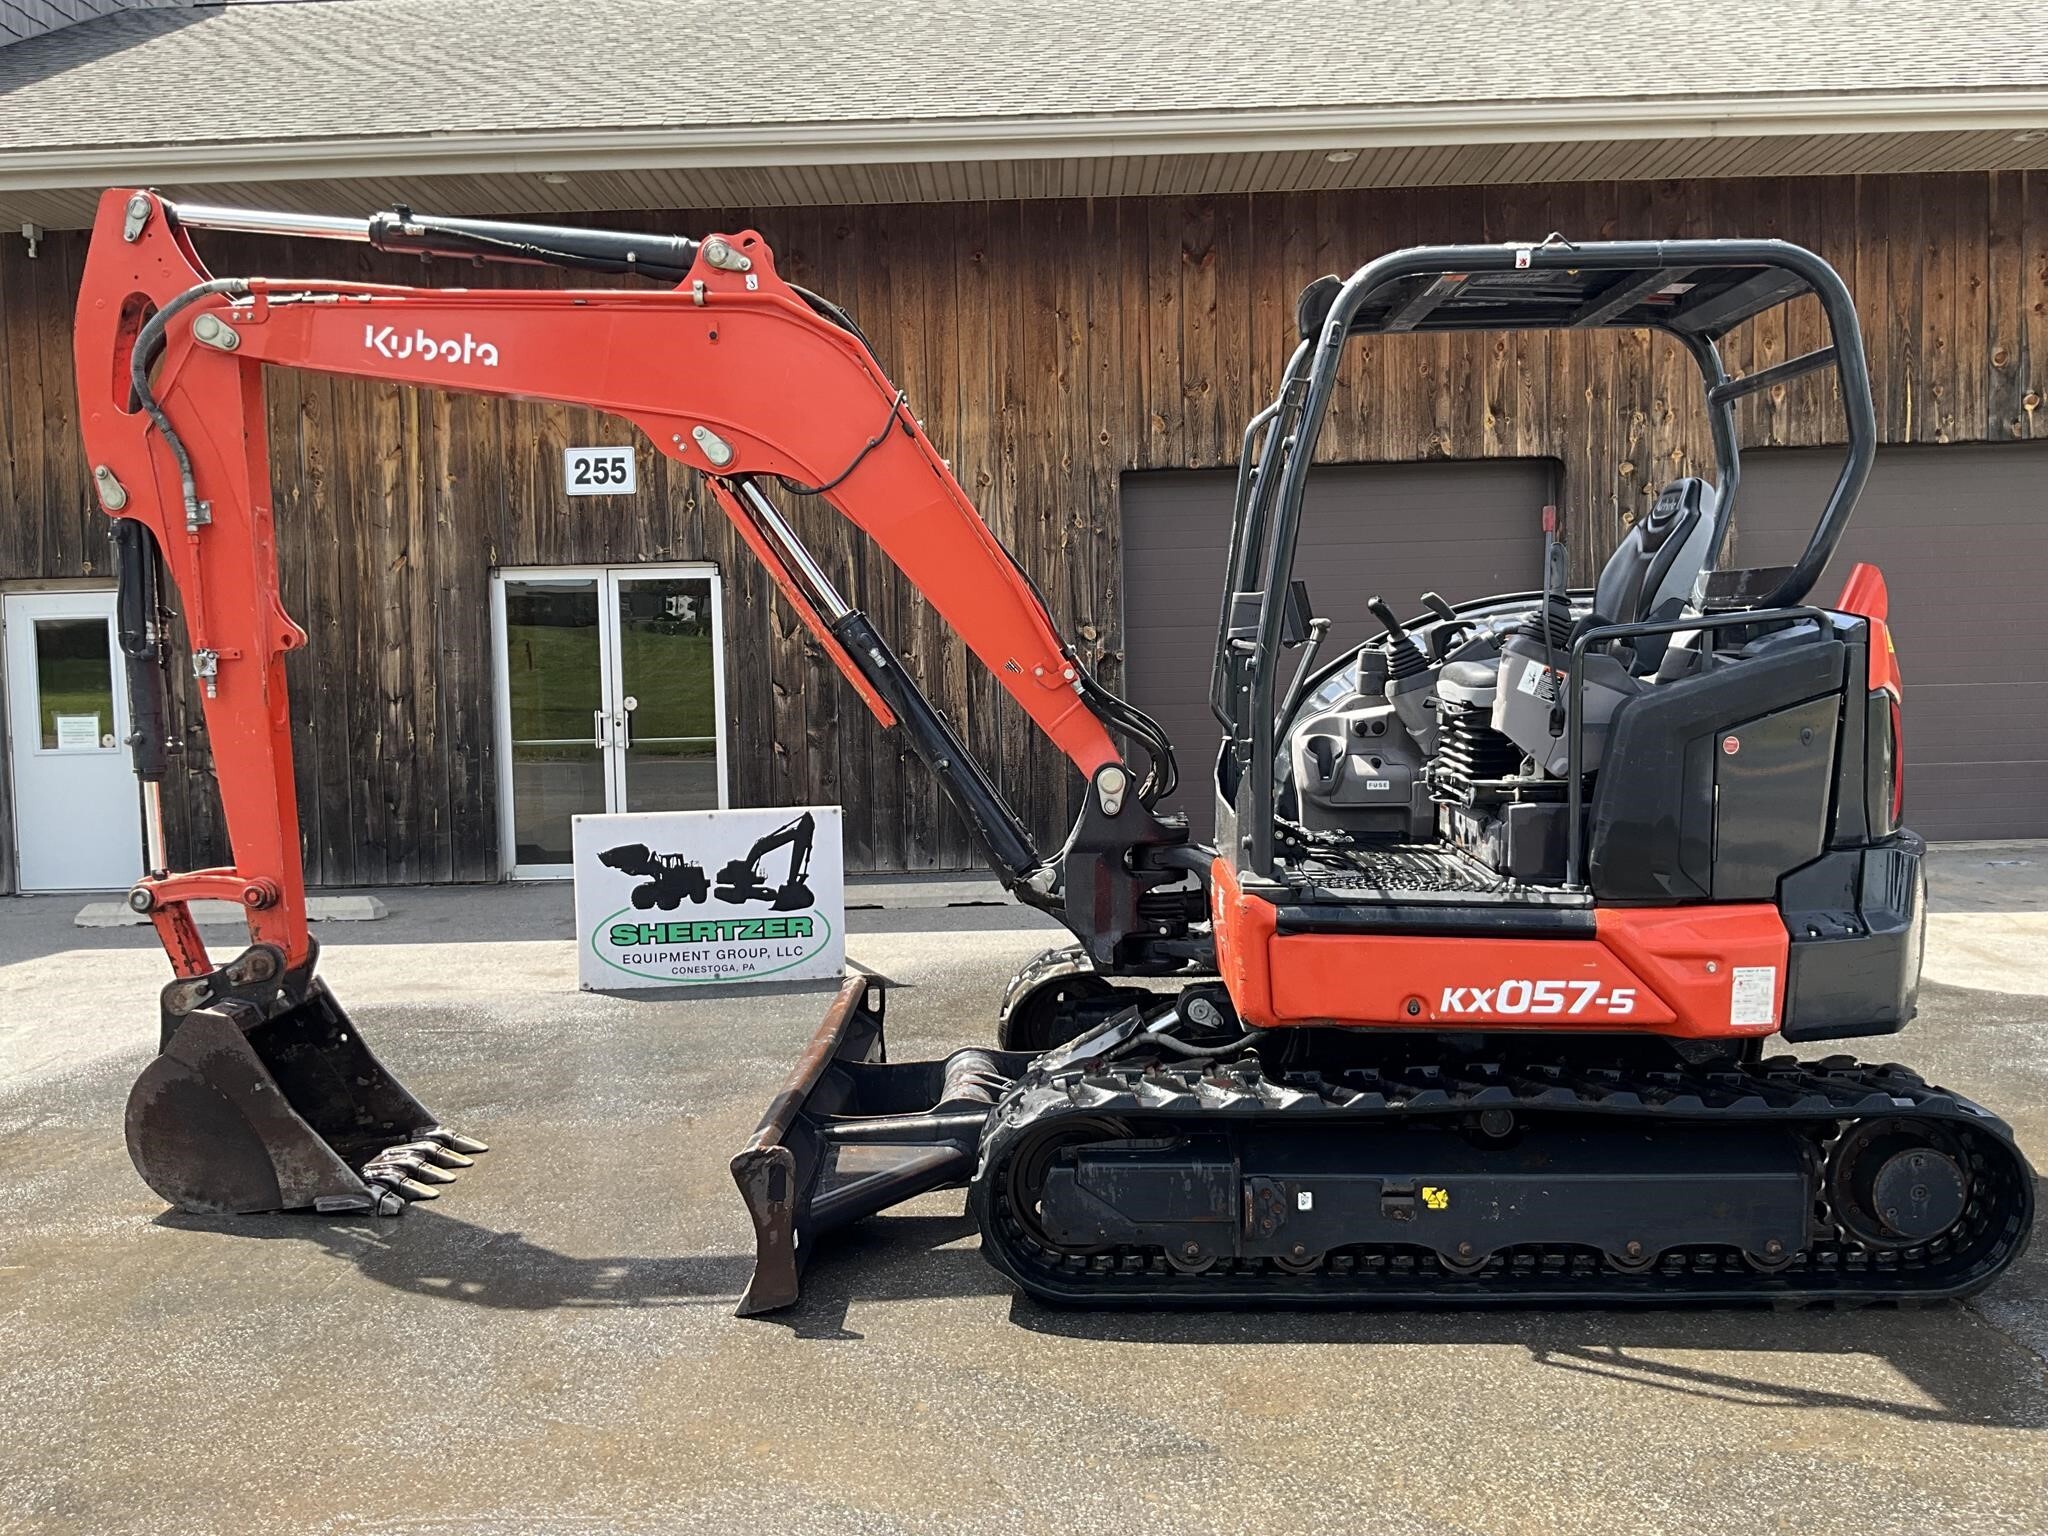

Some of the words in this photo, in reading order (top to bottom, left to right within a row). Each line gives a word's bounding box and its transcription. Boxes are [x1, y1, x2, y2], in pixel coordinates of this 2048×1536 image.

[365, 325, 499, 367] Kubota
[574, 457, 627, 485] 255
[610, 916, 814, 947] SHERTZER
[622, 950, 710, 965] EQUIPMENT
[716, 947, 771, 960] GROUP,
[776, 946, 804, 957] LLC
[671, 964, 739, 975] CONESTOGA,
[742, 963, 756, 971] PA
[1440, 979, 1636, 1015] KX057-5
